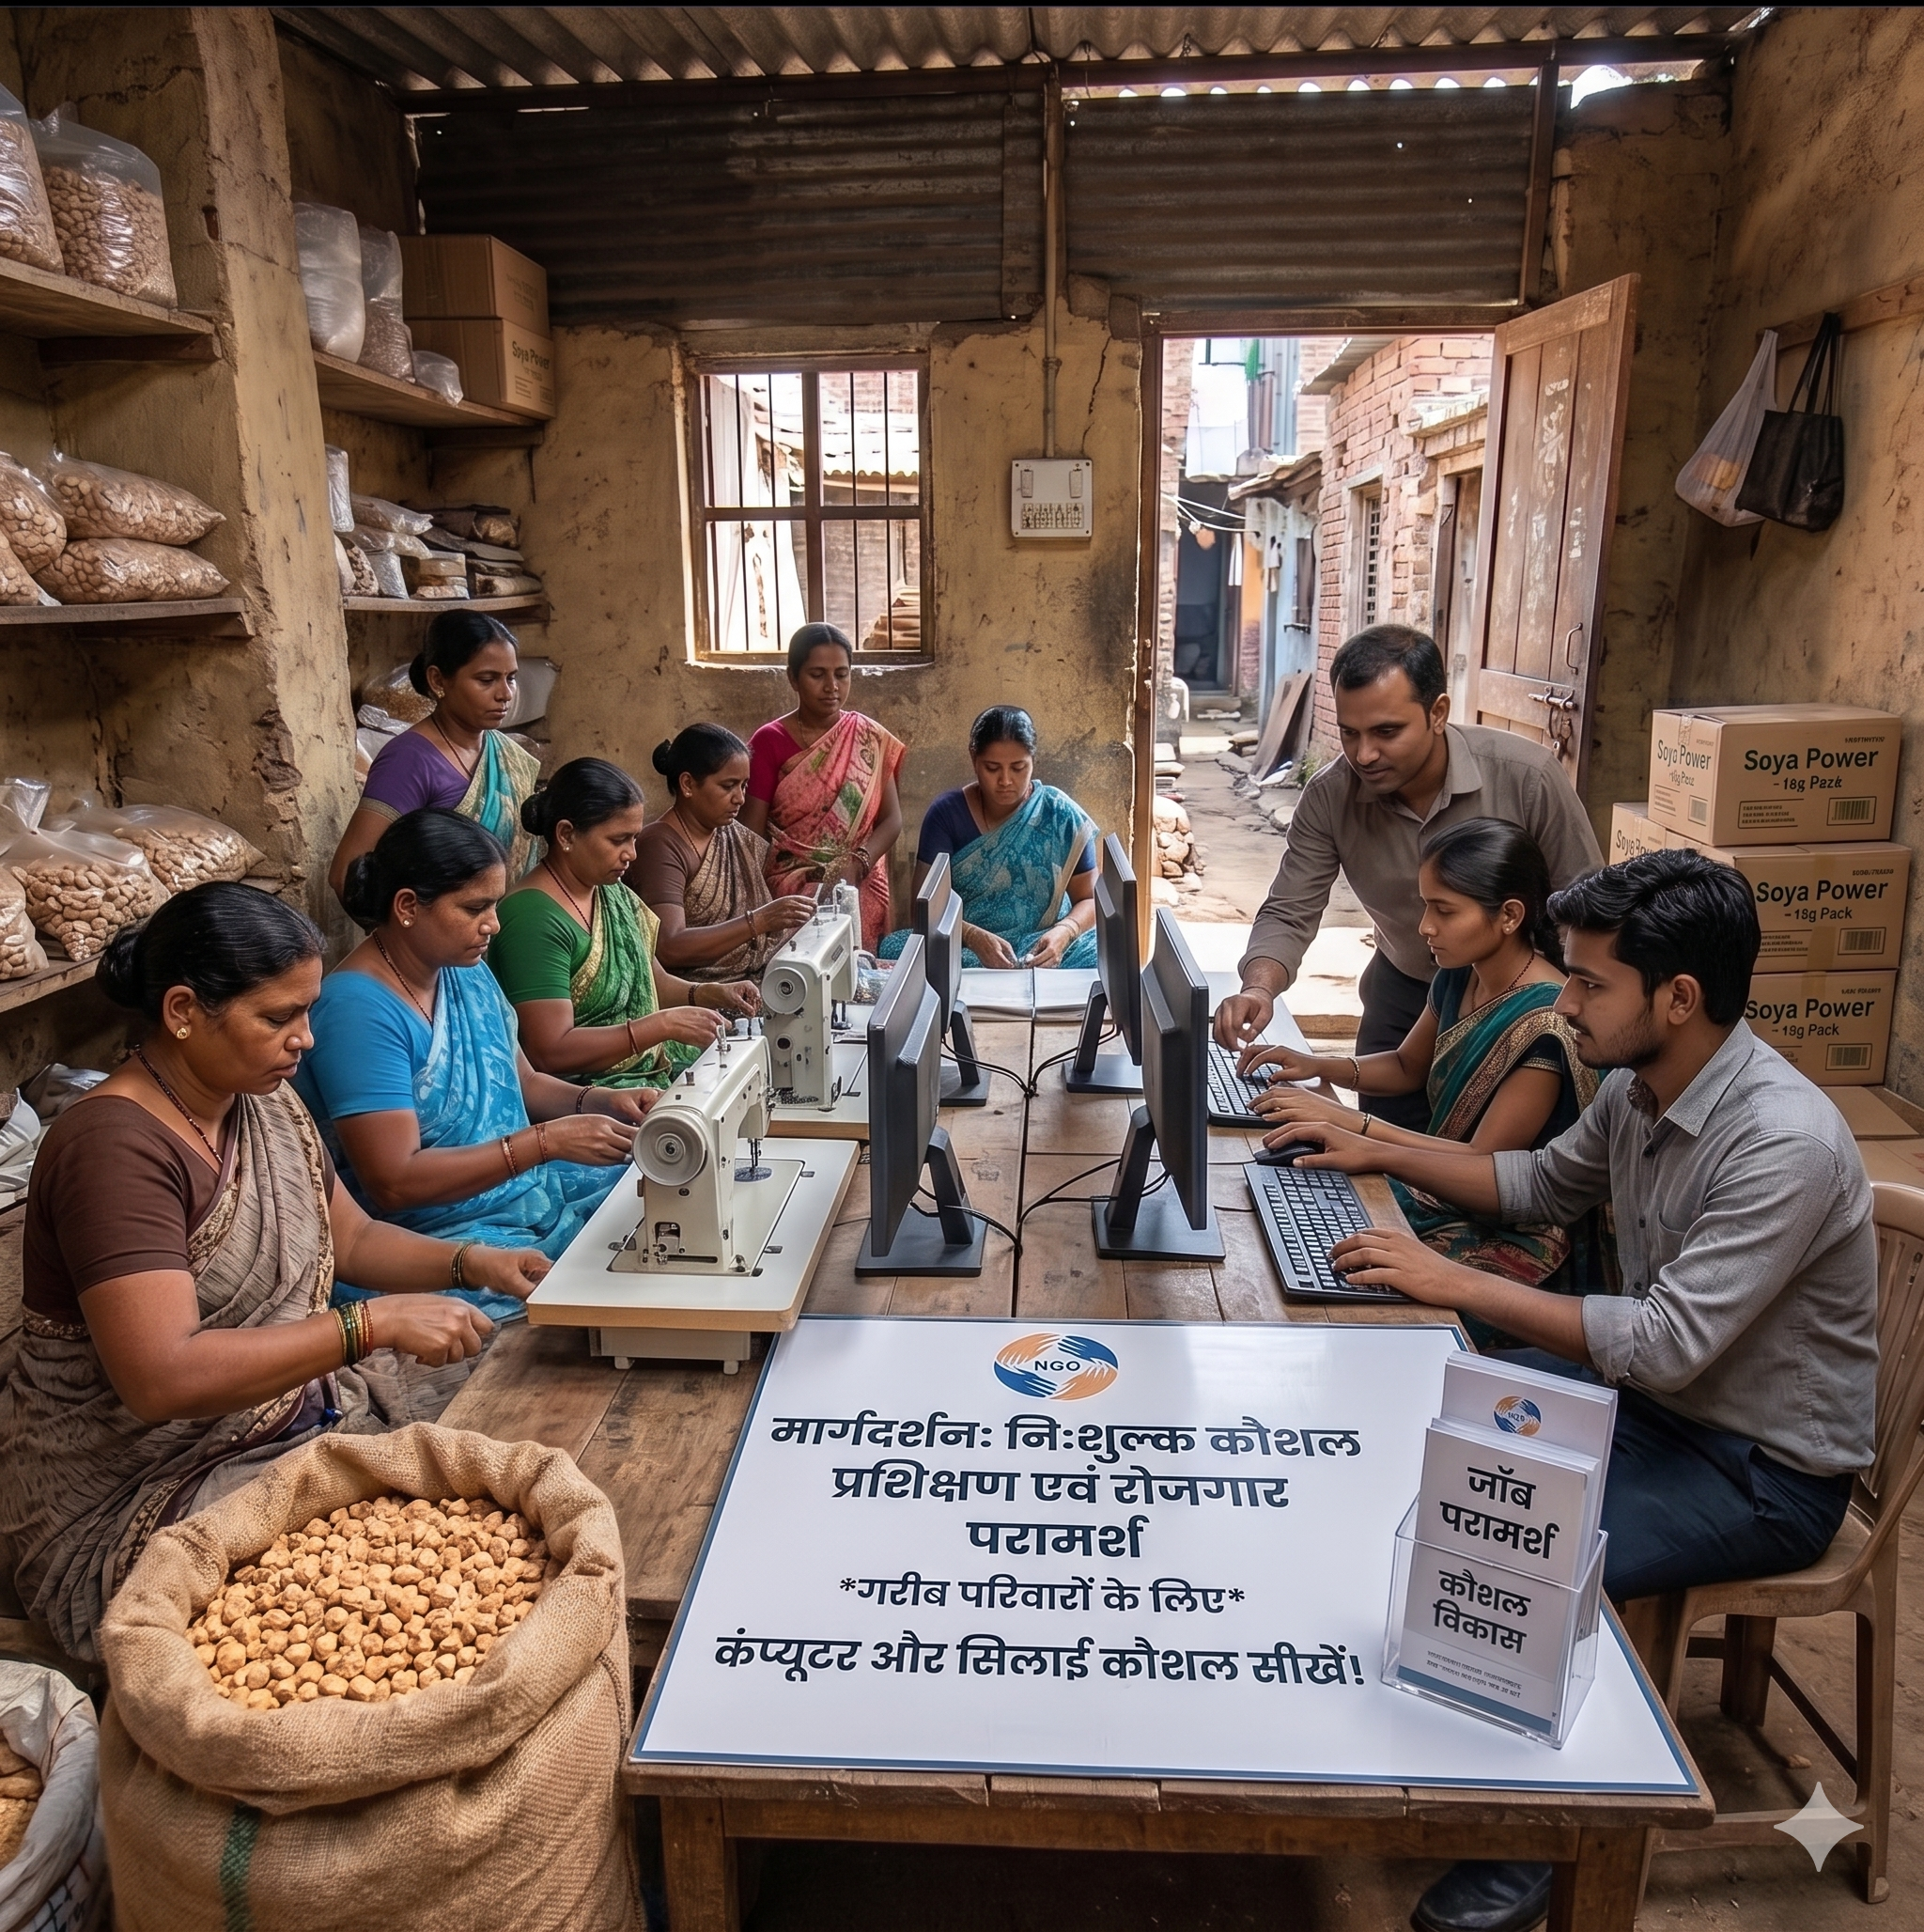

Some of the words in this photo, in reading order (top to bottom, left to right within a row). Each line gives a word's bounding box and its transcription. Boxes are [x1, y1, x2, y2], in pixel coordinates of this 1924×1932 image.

[1657, 739, 1678, 768] Soya
[1679, 744, 1712, 771] Power
[1744, 749, 1799, 776] Soya
[1806, 747, 1879, 770] Power
[1756, 881, 1809, 908] Soya
[1816, 880, 1889, 901] Power
[1820, 906, 1853, 920] Pack
[1745, 999, 1798, 1025] Soya
[1805, 998, 1875, 1019] Power
[1808, 1022, 1839, 1036] Pack
[1034, 1360, 1080, 1372] NGO
[1205, 1416, 1361, 1457] कौशल
[831, 1458, 1021, 1503] प्रशिक्षण
[1030, 1464, 1101, 1504] एवं
[1109, 1465, 1289, 1508] रोजगार
[1466, 1464, 1537, 1510] जॉब
[965, 1514, 1150, 1558] परामर्श
[1439, 1501, 1560, 1560] परामर्श
[957, 1573, 1095, 1611] परिवारों
[1100, 1577, 1141, 1612] के
[1438, 1568, 1531, 1617] कौशल
[1432, 1598, 1528, 1654] विकास
[715, 1628, 862, 1682] कंप्यूटर
[871, 1629, 949, 1674] और
[955, 1633, 1095, 1681] सिलाई
[1098, 1636, 1239, 1681] कौशल
[1246, 1642, 1365, 1686] सीखें!
